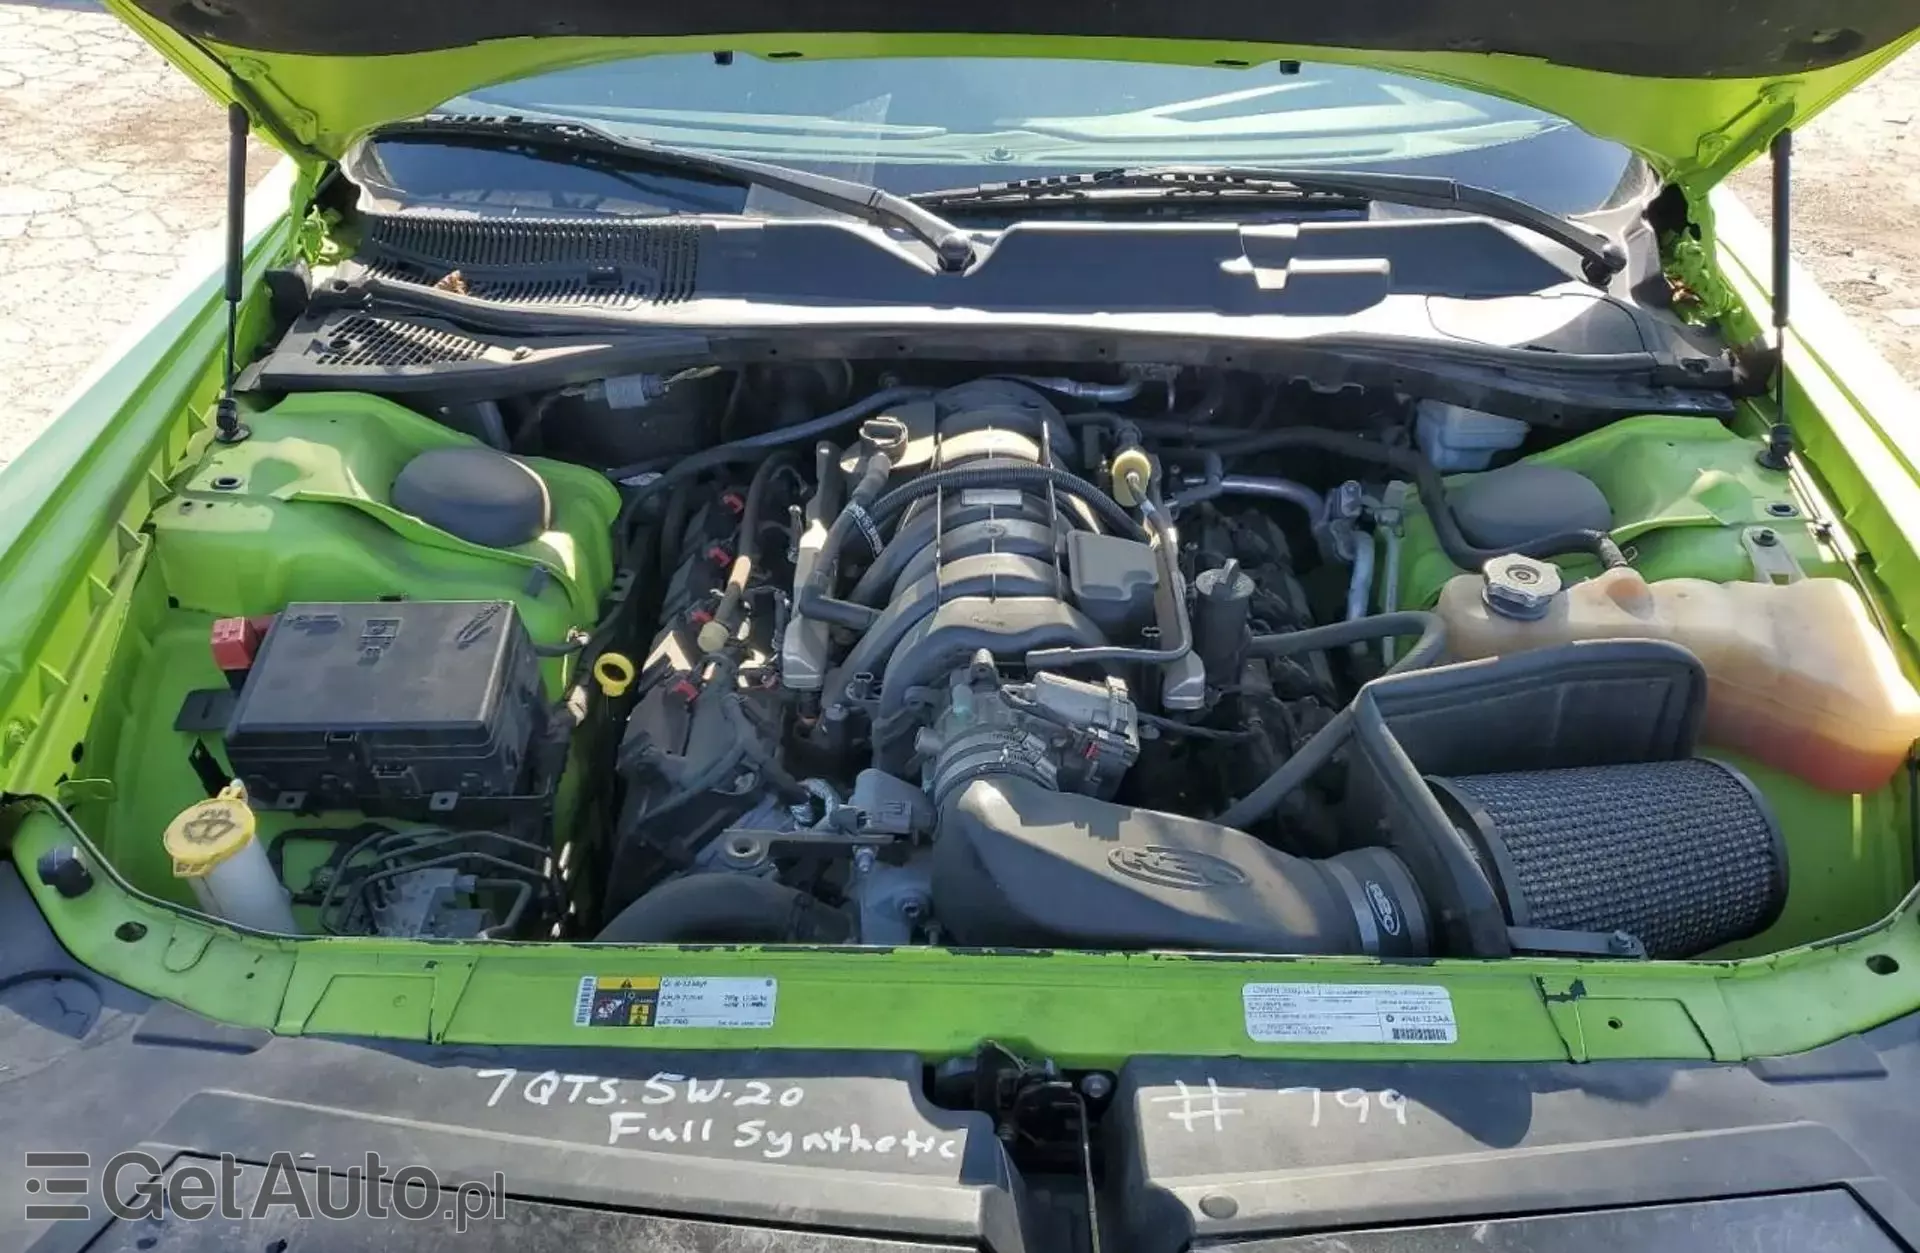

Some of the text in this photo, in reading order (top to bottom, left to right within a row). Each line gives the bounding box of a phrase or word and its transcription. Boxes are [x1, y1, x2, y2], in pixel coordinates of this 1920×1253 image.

[477, 1068, 517, 1107] 7
[1150, 1078, 1406, 1133] # 799
[608, 1111, 956, 1158] Full Synthetic
